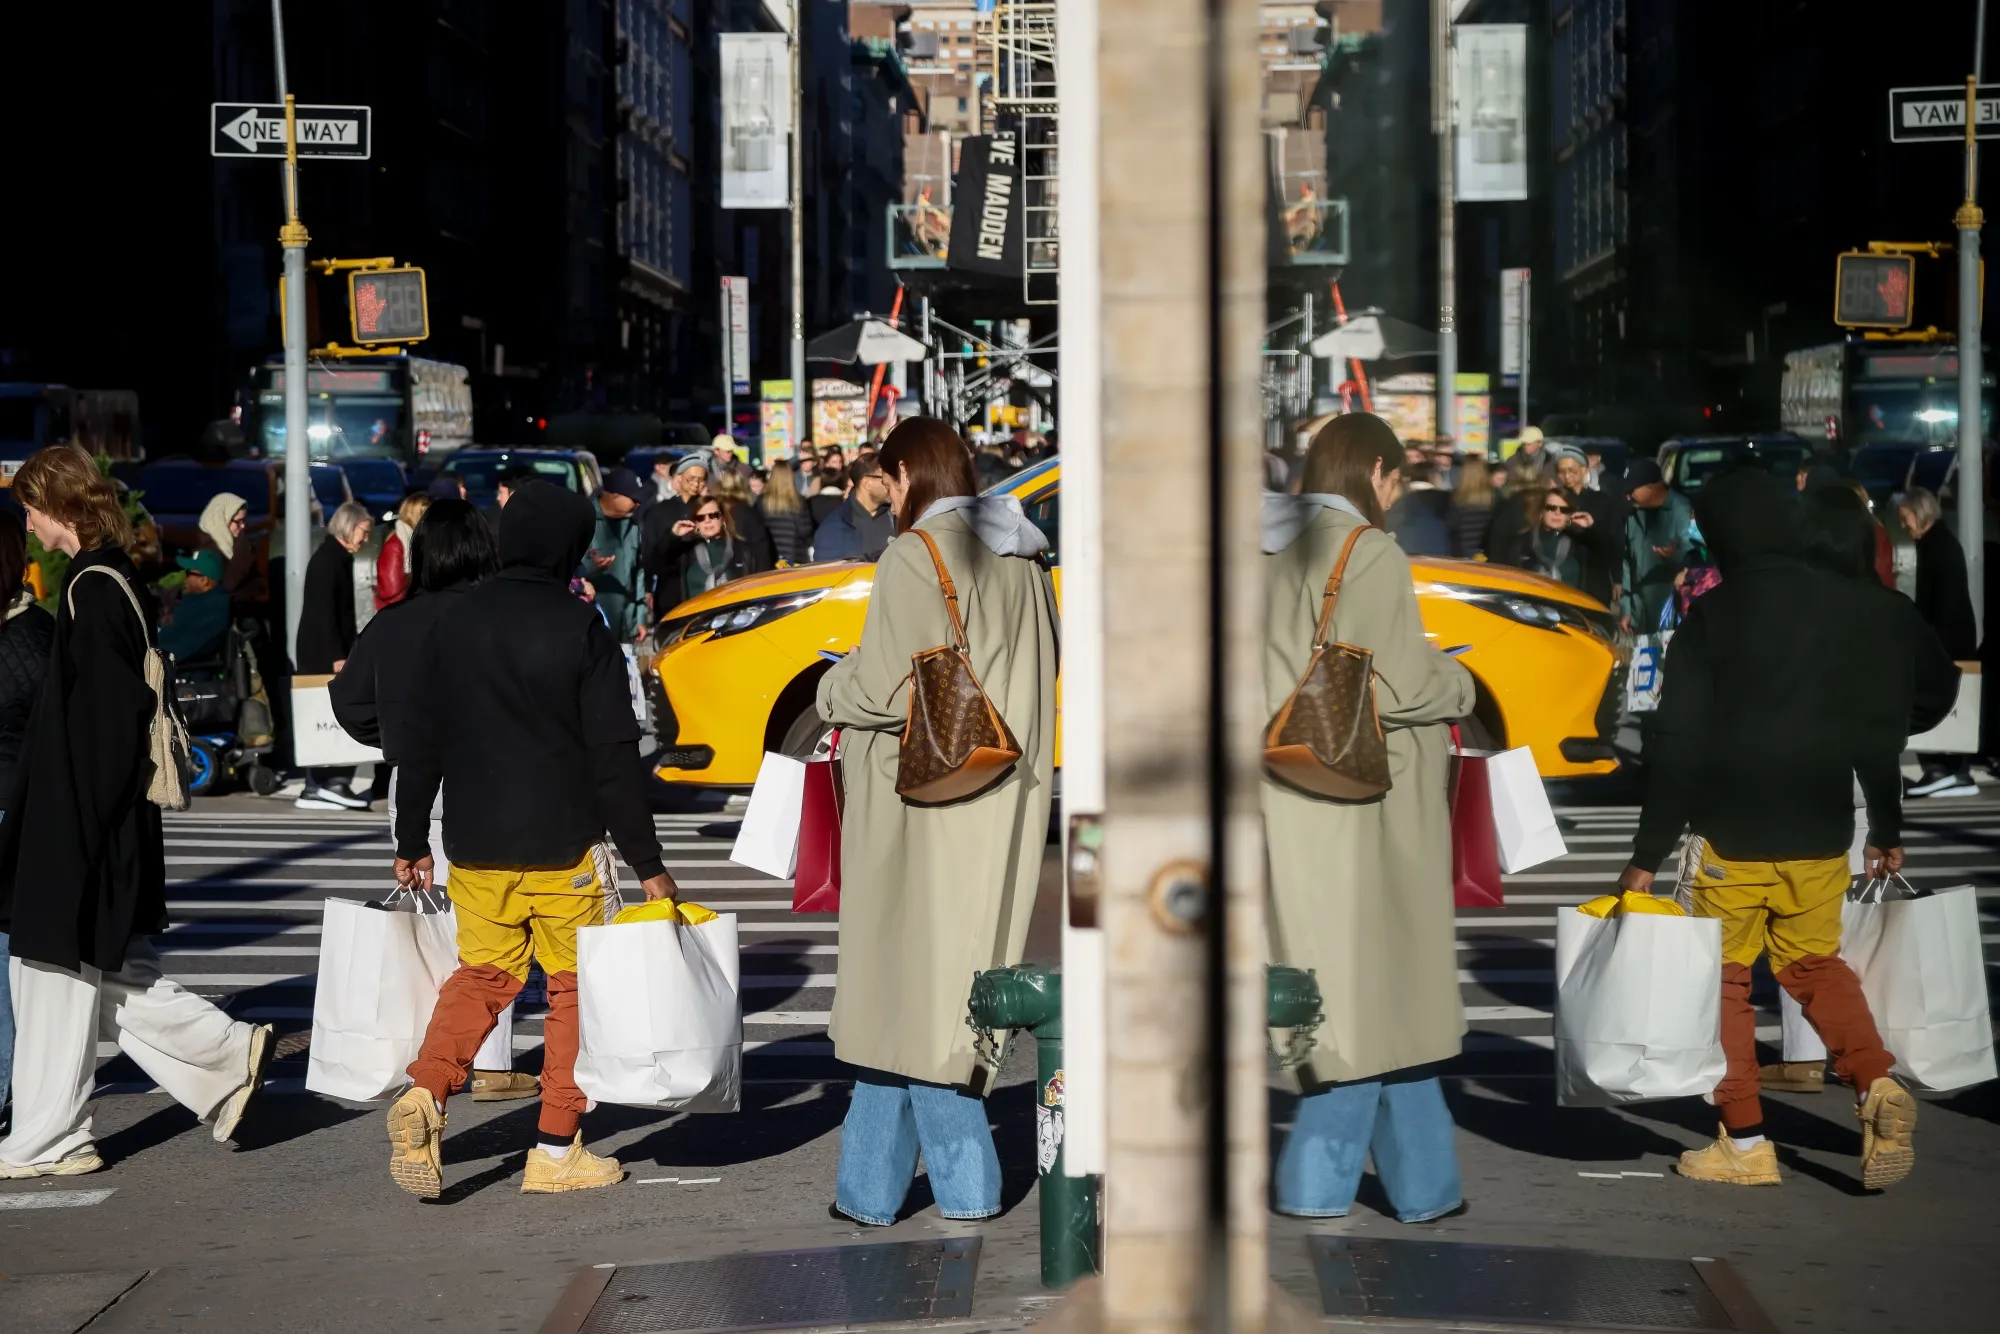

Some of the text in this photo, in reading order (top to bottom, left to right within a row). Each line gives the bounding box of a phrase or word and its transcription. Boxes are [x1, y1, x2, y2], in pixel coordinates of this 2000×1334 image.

[238, 121, 348, 141] ONE WAY
[976, 173, 1012, 260] MADDEN
